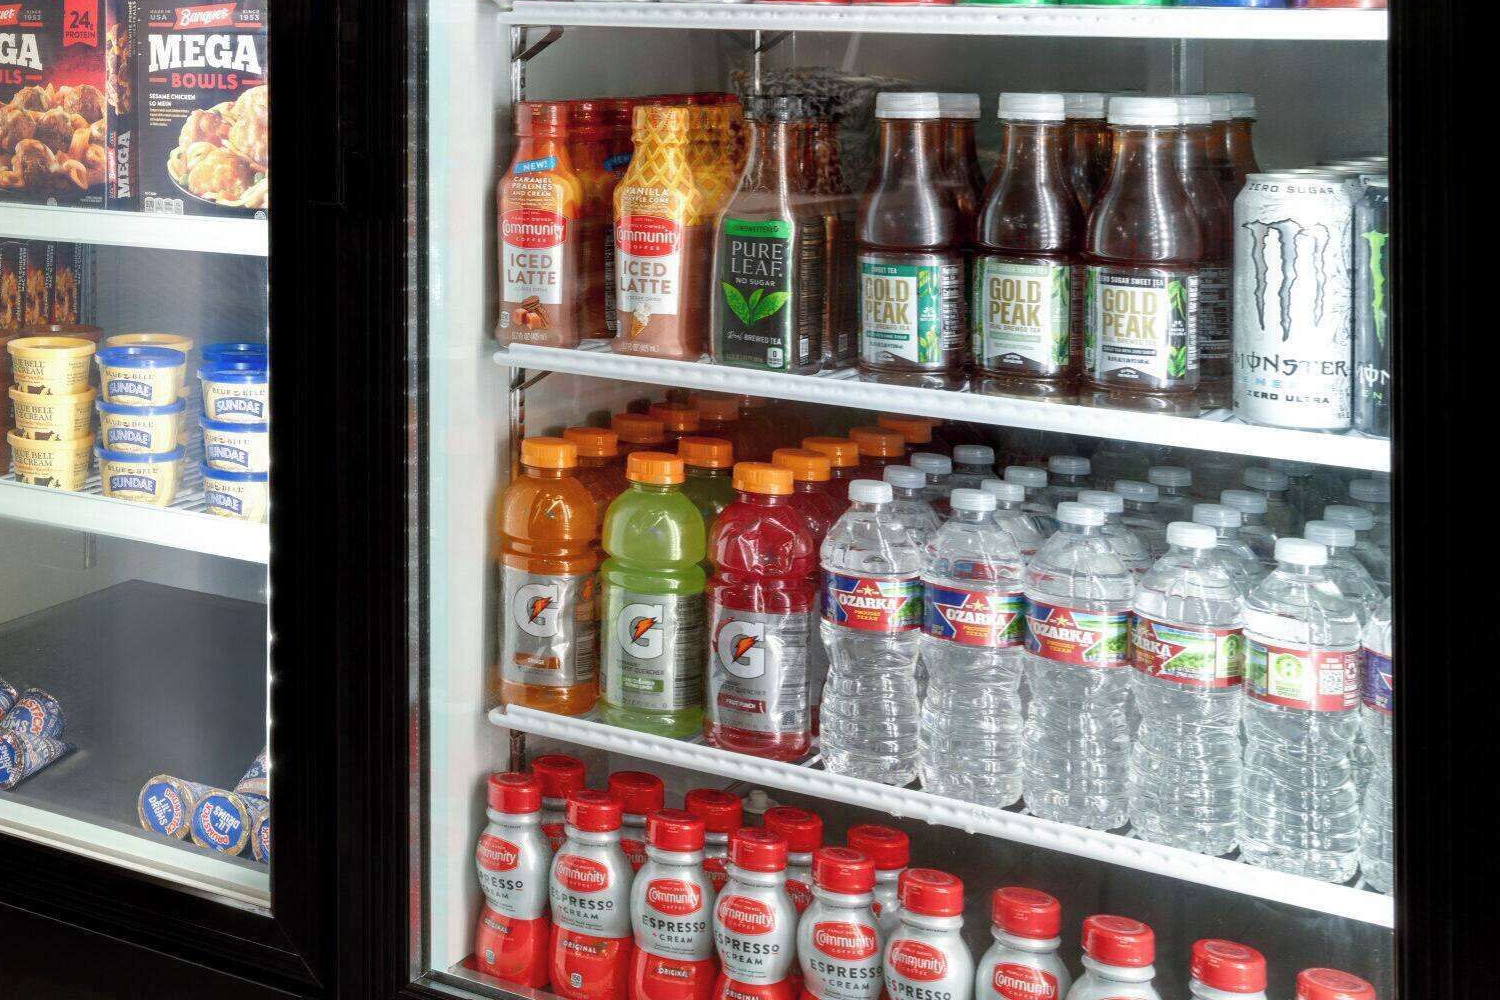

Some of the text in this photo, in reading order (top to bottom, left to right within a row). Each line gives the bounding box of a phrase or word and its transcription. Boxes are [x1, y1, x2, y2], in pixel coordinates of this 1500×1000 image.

[179, 7, 230, 27] Banquet
[65, 31, 96, 39] PROTEIN
[148, 34, 262, 75] MEGA
[171, 72, 239, 90] BOWLS
[117, 130, 131, 199] MEGA
[523, 160, 548, 172] NEW!
[512, 183, 553, 191] PRALINES
[513, 176, 553, 184] CARAMEL
[1249, 183, 1336, 195] ZERO SUGAR
[626, 186, 669, 197] VANILLA
[503, 218, 564, 237] Community
[616, 226, 679, 246] Community
[731, 240, 784, 260] PURE
[510, 253, 553, 269] ICED
[624, 260, 667, 277] ICED
[507, 269, 557, 286] LATTE
[620, 276, 671, 295] LATTE
[749, 279, 776, 287] SUGAR
[1111, 276, 1165, 287] SUGAR SWEET TEA
[865, 278, 910, 303] GOLD
[988, 277, 1042, 304] GOLD
[1101, 288, 1157, 316] GOLD
[865, 300, 909, 325] PEAK
[988, 302, 1042, 327] PEAK
[1101, 313, 1157, 340] PEAK
[744, 333, 783, 346] BREWED TEA
[109, 382, 150, 399] SUNDAE
[1246, 389, 1279, 402] ZERO
[216, 399, 261, 416] SUNDAE
[109, 430, 150, 447] SUNDAE
[111, 477, 154, 494] SUNDAE
[839, 592, 898, 609] OZARKA
[513, 584, 559, 638] G
[946, 609, 1006, 626] OZARKA
[616, 603, 665, 660] G
[1033, 621, 1094, 645] OZARKA
[717, 620, 766, 679] G
[148, 795, 168, 826] DRUMS
[213, 805, 241, 829] DRUMS
[201, 801, 230, 845] DRUMSTICK
[555, 860, 607, 885] Community
[649, 886, 700, 907] Community
[563, 906, 599, 920] CREAM
[719, 902, 775, 926] Community
[642, 914, 707, 933] ESPRESSO
[562, 939, 598, 954] ORIGINAL
[659, 934, 694, 944] CREAM
[715, 929, 781, 955] ESPRESSO
[815, 928, 876, 950] Community
[726, 951, 763, 966] CREAM
[891, 946, 946, 974] Community
[810, 958, 883, 979] ESPRESSO
[829, 978, 870, 991] CREAM
[994, 970, 1056, 997] Community
